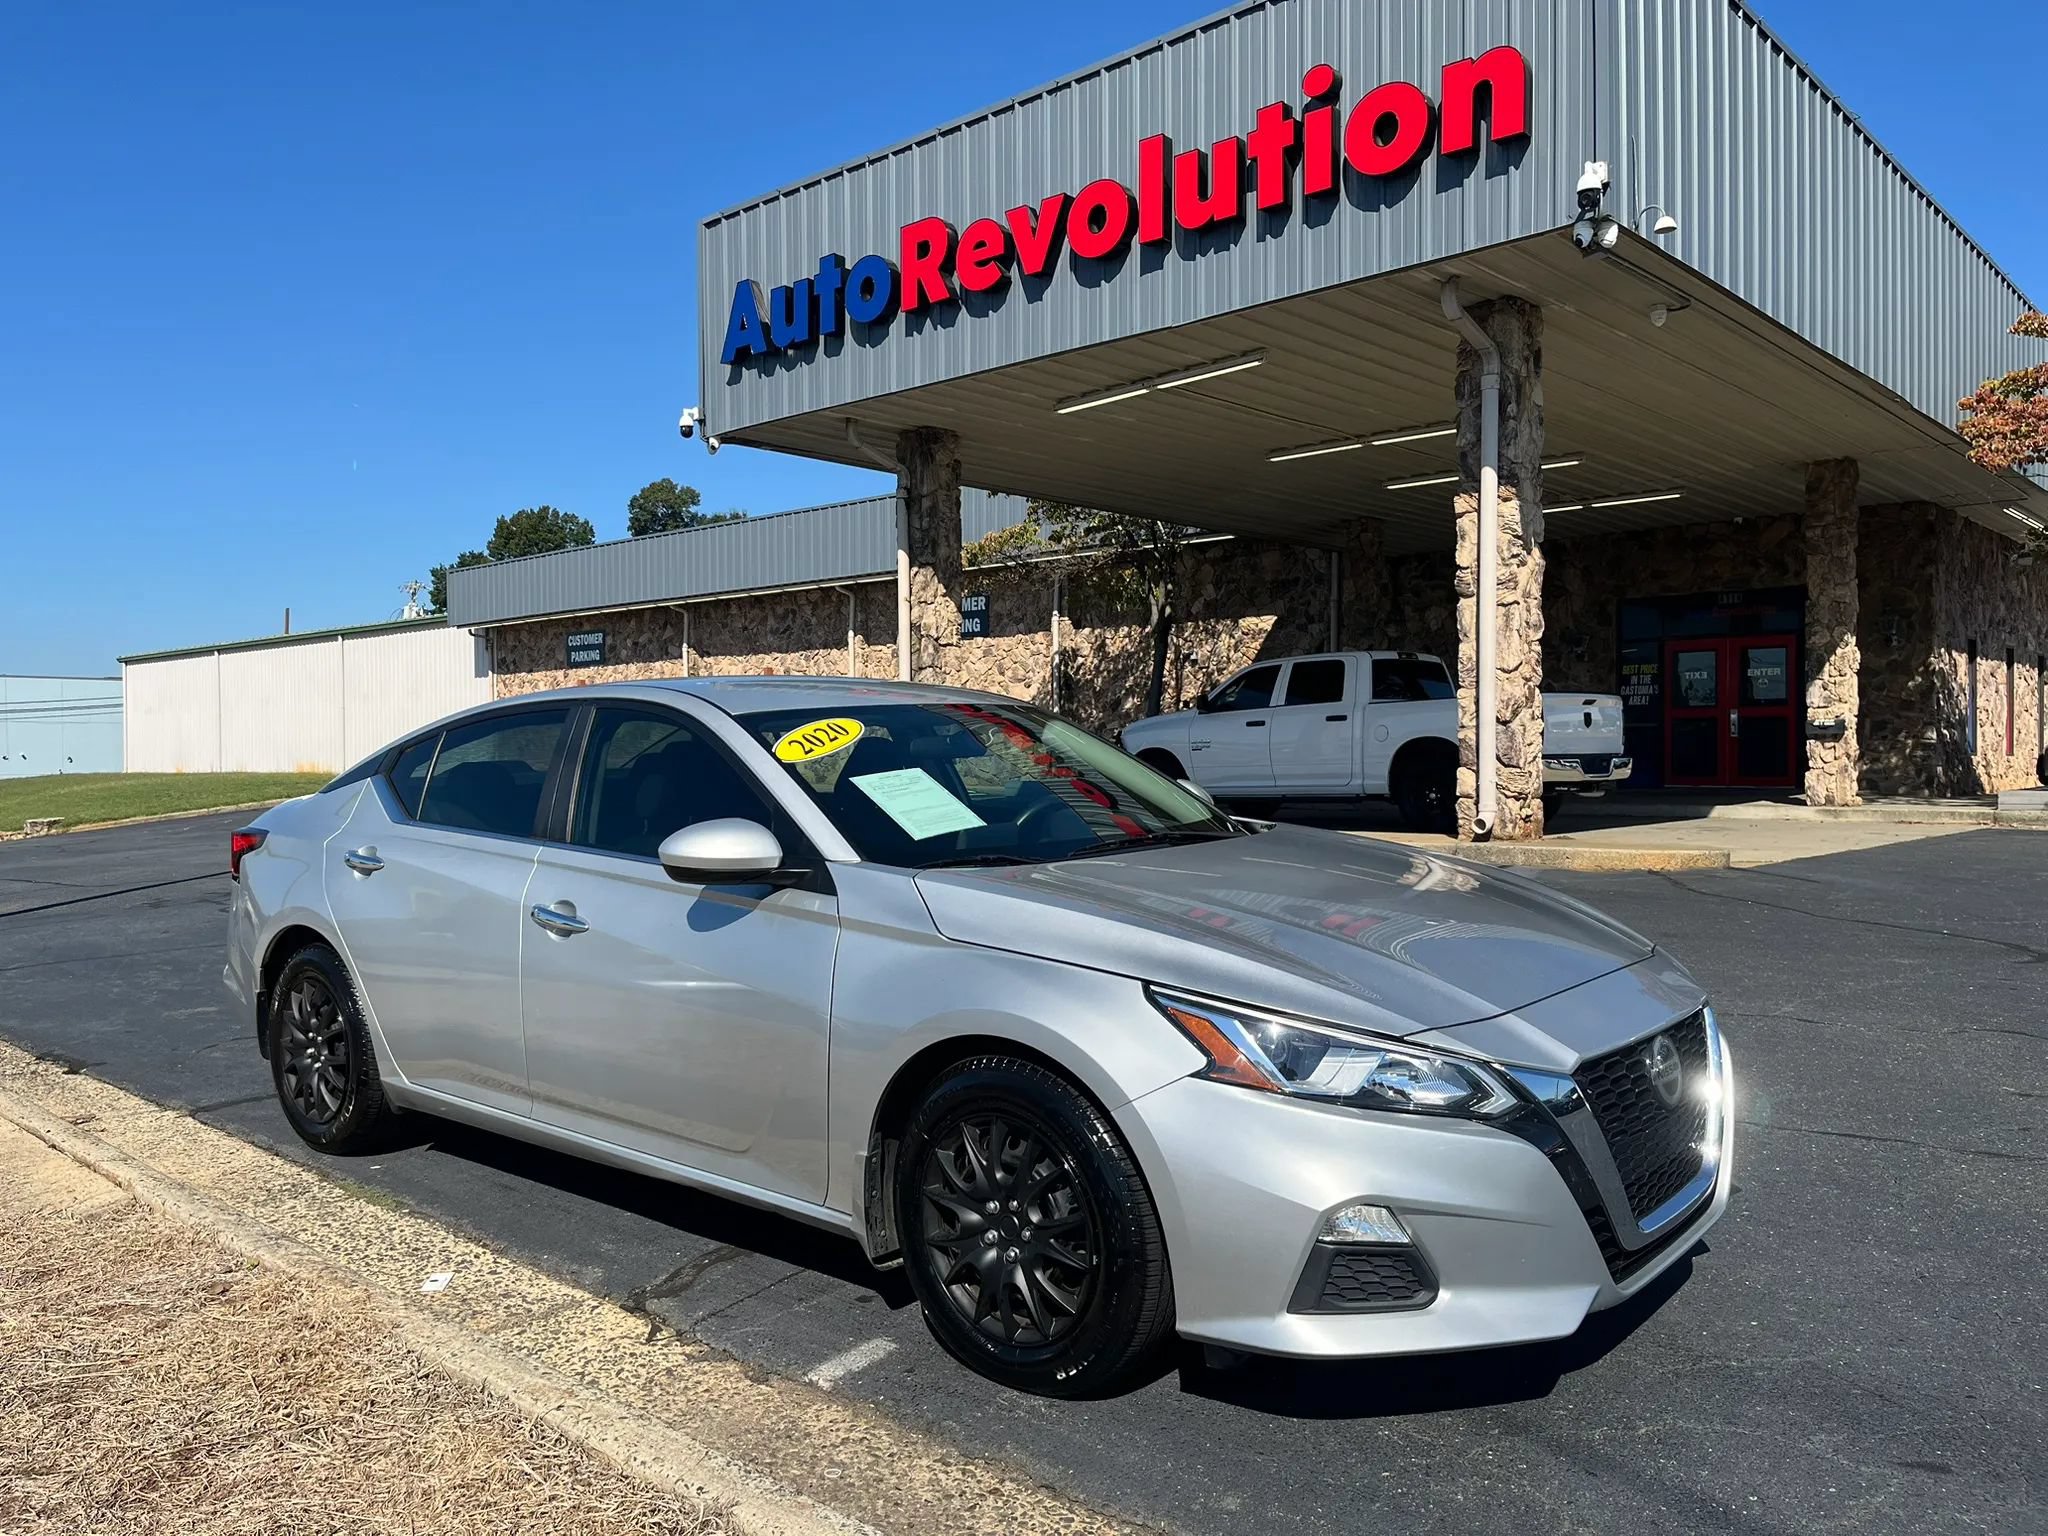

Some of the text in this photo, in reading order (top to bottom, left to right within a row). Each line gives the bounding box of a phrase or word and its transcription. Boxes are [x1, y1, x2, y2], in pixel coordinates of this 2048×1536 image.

[720, 45, 1530, 365] AutoRevolution
[567, 632, 603, 647] CUSTOMER
[571, 649, 600, 663] PARKING
[1640, 663, 1658, 674] PRICE
[1747, 667, 1781, 677] ENTER
[1630, 674, 1652, 685] IN THE
[788, 723, 849, 755] 2020
